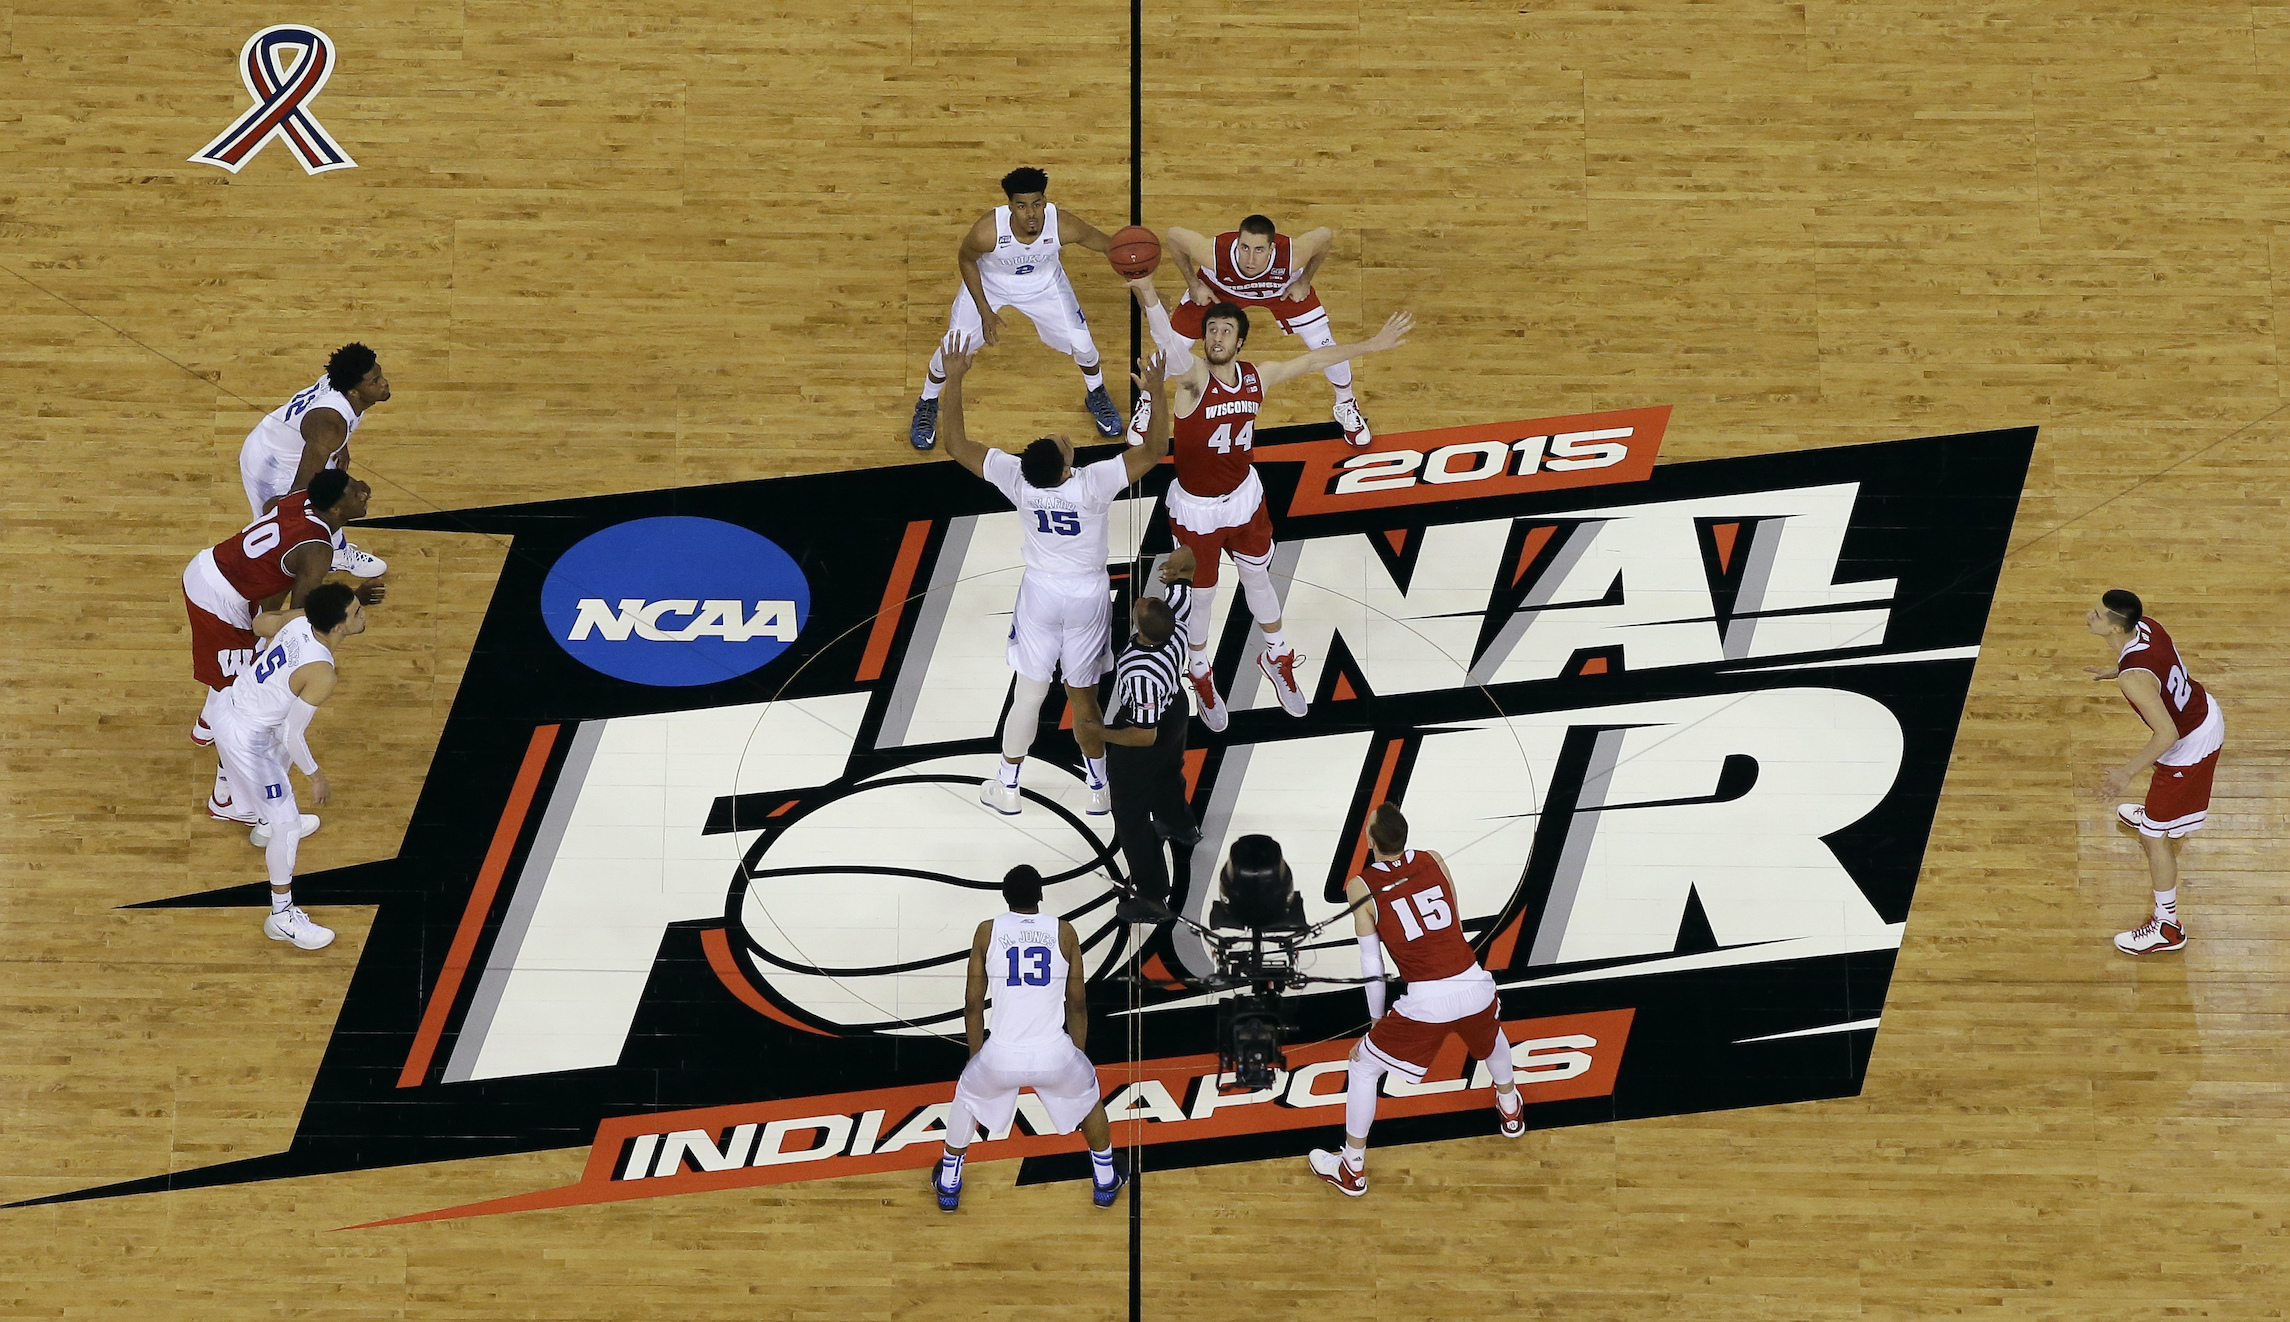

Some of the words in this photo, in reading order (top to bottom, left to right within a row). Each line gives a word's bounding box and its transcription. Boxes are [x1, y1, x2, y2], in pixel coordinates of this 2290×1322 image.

[1014, 265, 1035, 275] 2
[1207, 419, 1255, 455] 44
[1330, 426, 1634, 496] 2015
[1033, 509, 1082, 536] 15
[567, 598, 799, 643] NCAA
[255, 644, 287, 684] 5
[2166, 663, 2193, 713] 2
[1390, 885, 1453, 942] 15
[998, 933, 1016, 949] M.
[1018, 930, 1057, 949] JONES
[1006, 946, 1052, 987] 13
